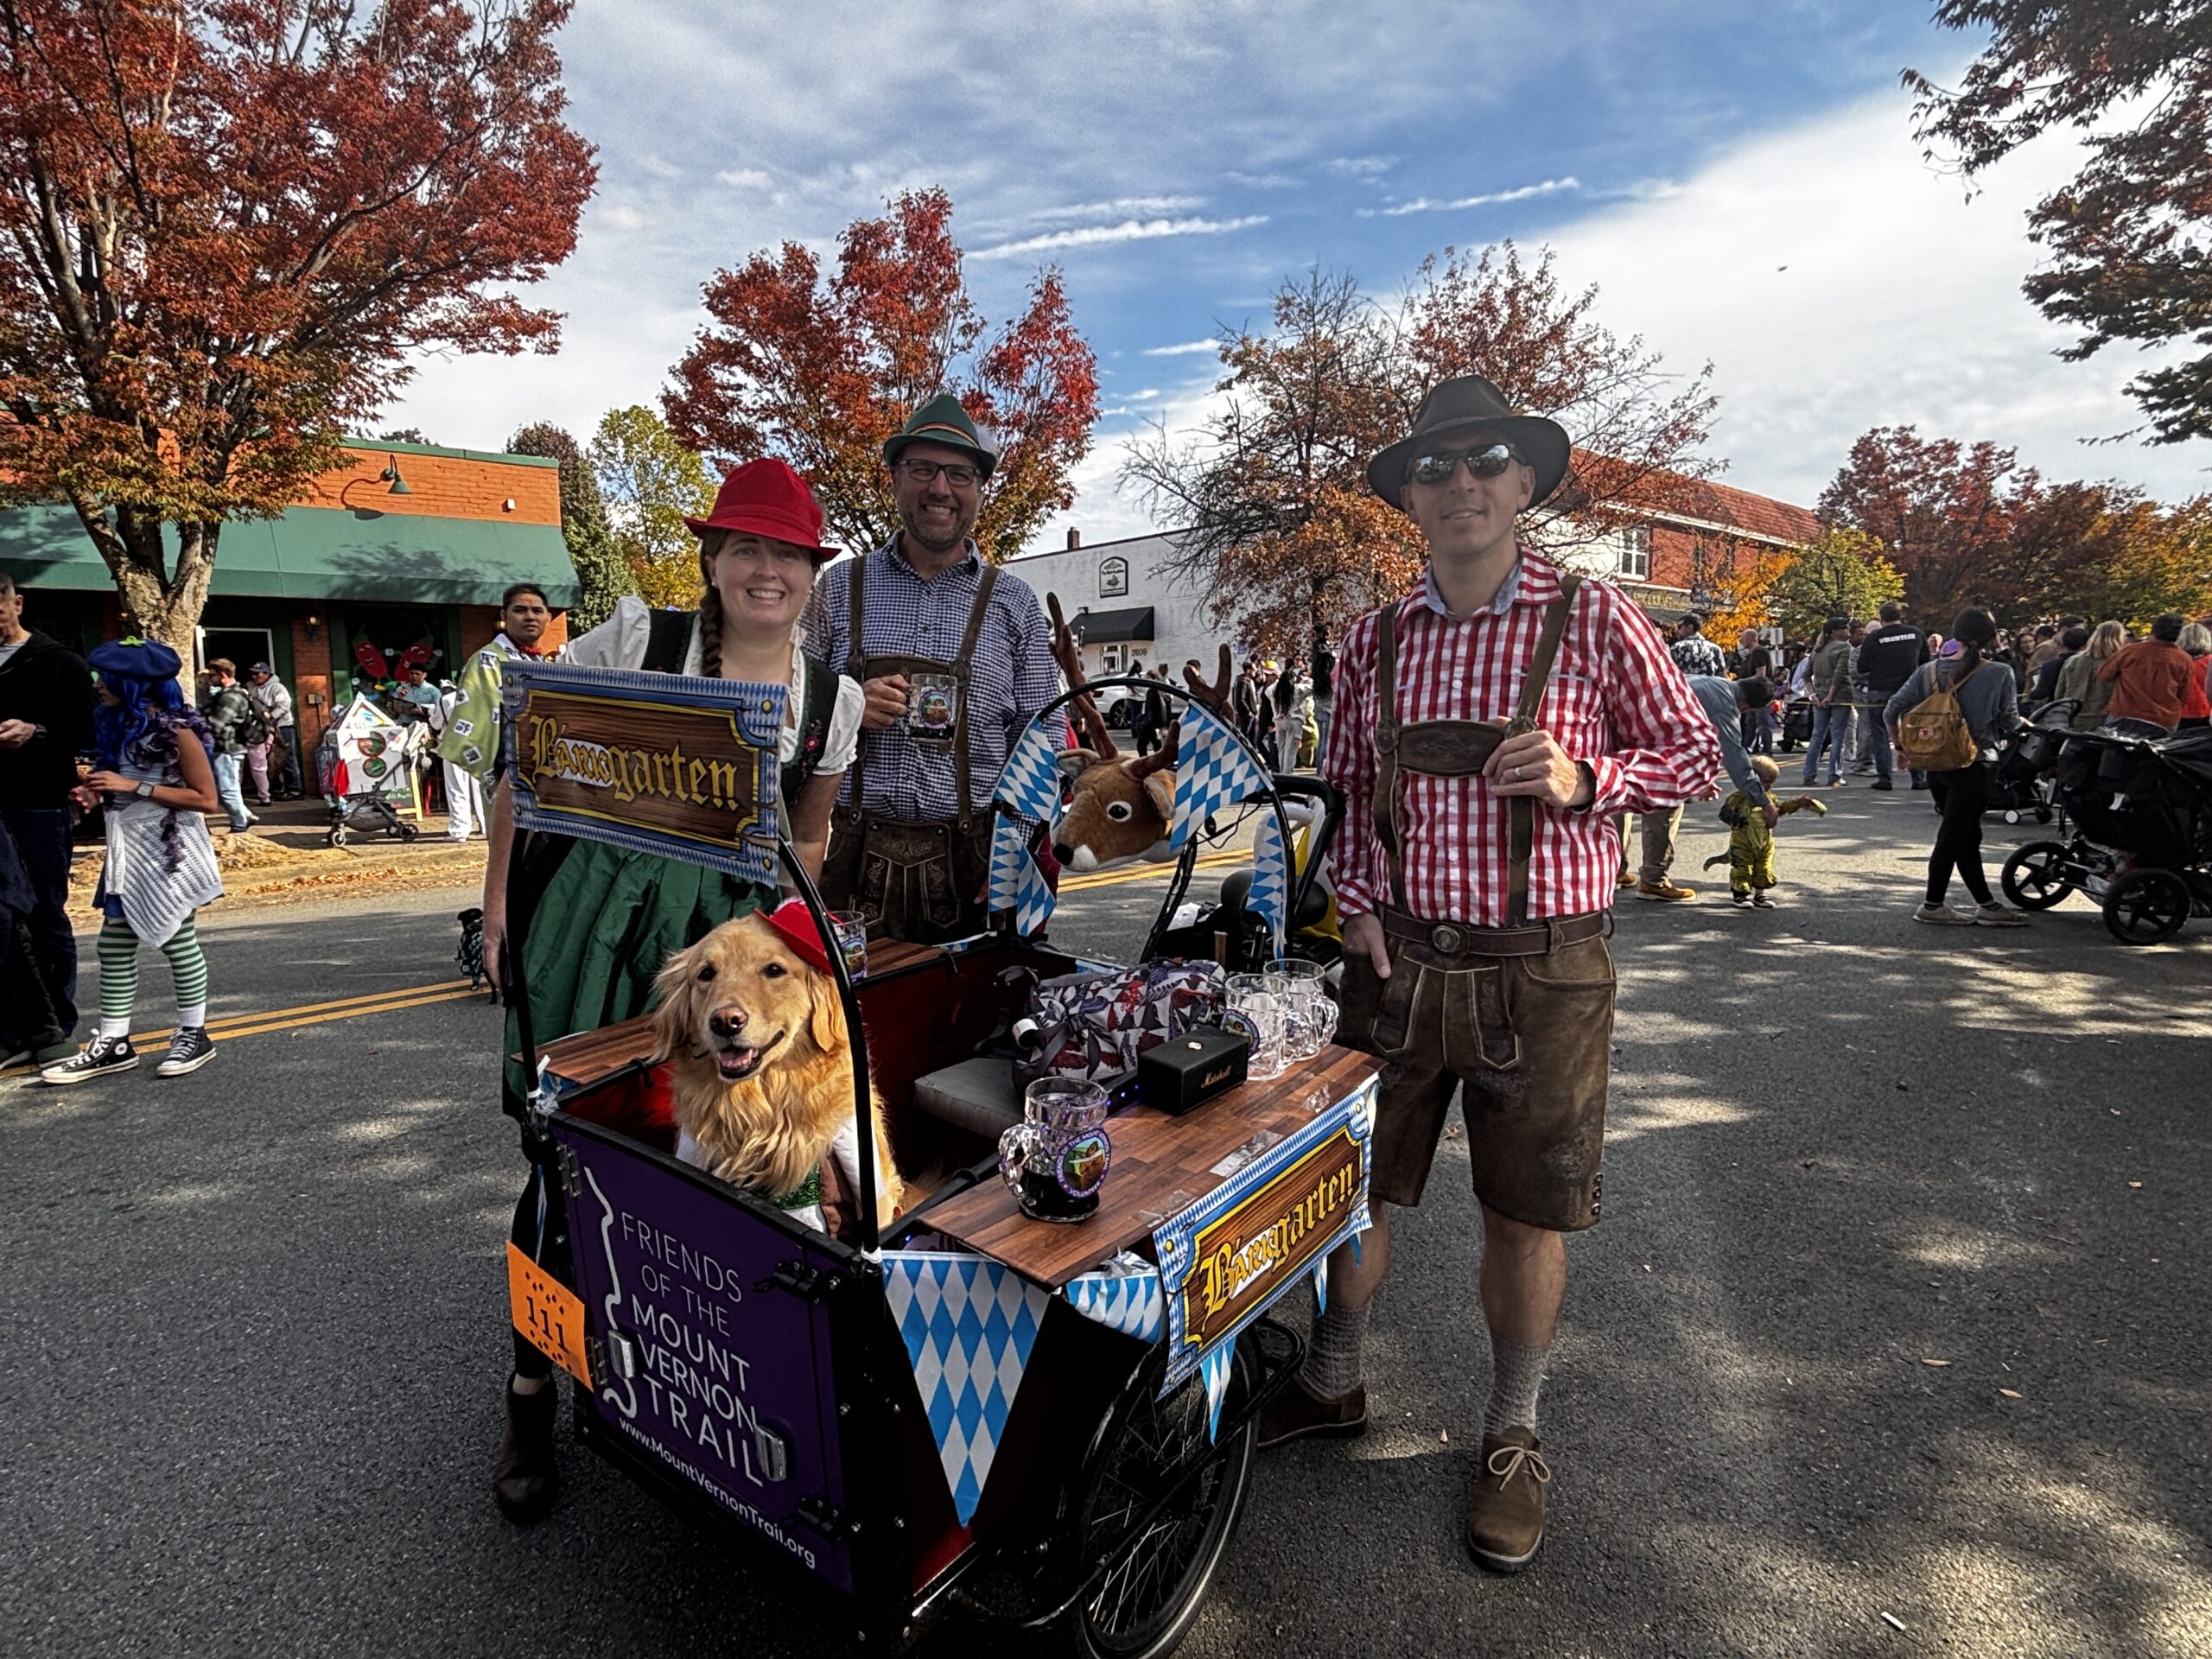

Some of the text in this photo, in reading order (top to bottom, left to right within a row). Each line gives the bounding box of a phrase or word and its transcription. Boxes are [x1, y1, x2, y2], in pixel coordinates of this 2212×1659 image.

[1878, 632, 1916, 645] VOLUNTEER
[621, 1211, 742, 1303] FRIENDS
[641, 1265, 729, 1338] OF THE
[525, 1294, 569, 1355] 111
[632, 1294, 750, 1392] MOUNT
[637, 1333, 757, 1433] VERNON
[643, 1373, 764, 1487] TRAIL
[619, 1417, 816, 1569] www.MountVernonTrail.org
